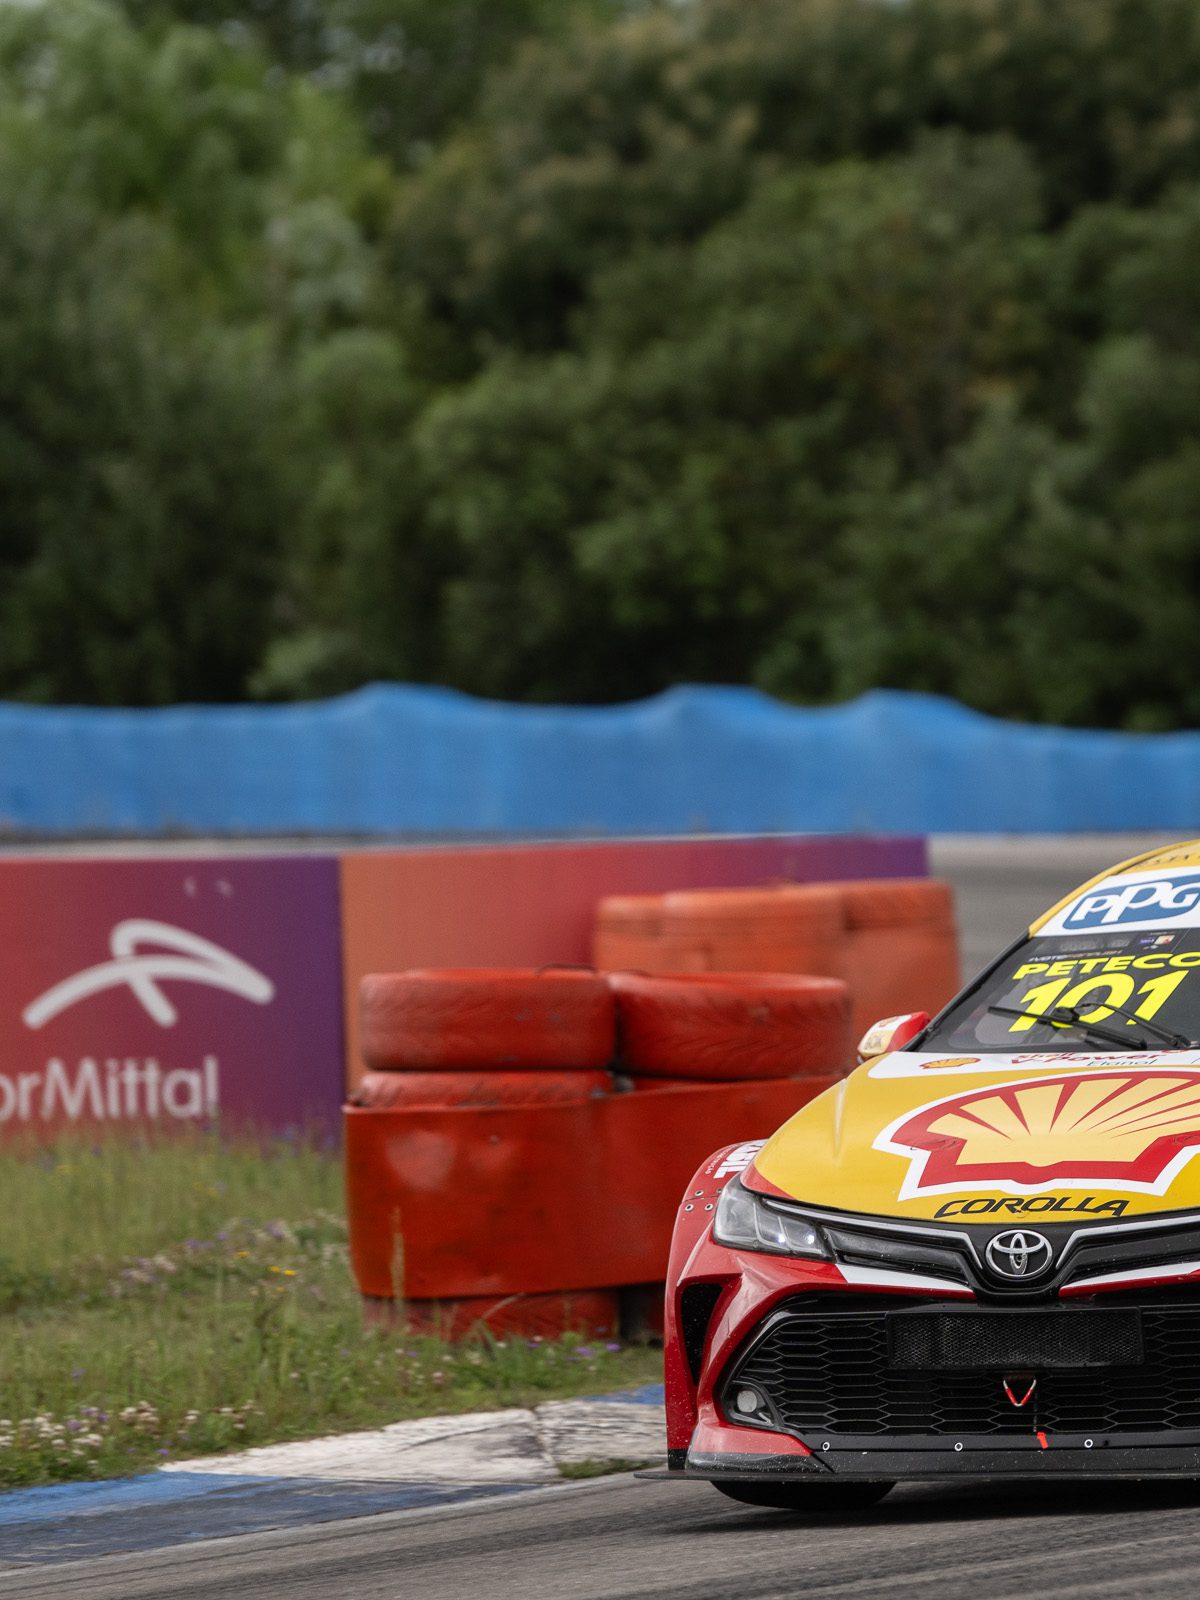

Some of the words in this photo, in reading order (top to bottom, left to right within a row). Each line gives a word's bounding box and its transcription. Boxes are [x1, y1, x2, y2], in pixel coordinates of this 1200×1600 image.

[1008, 969, 1189, 1033] 101
[1011, 1053, 1167, 1065] V-Power
[933, 1196, 1130, 1219] COROLLA
